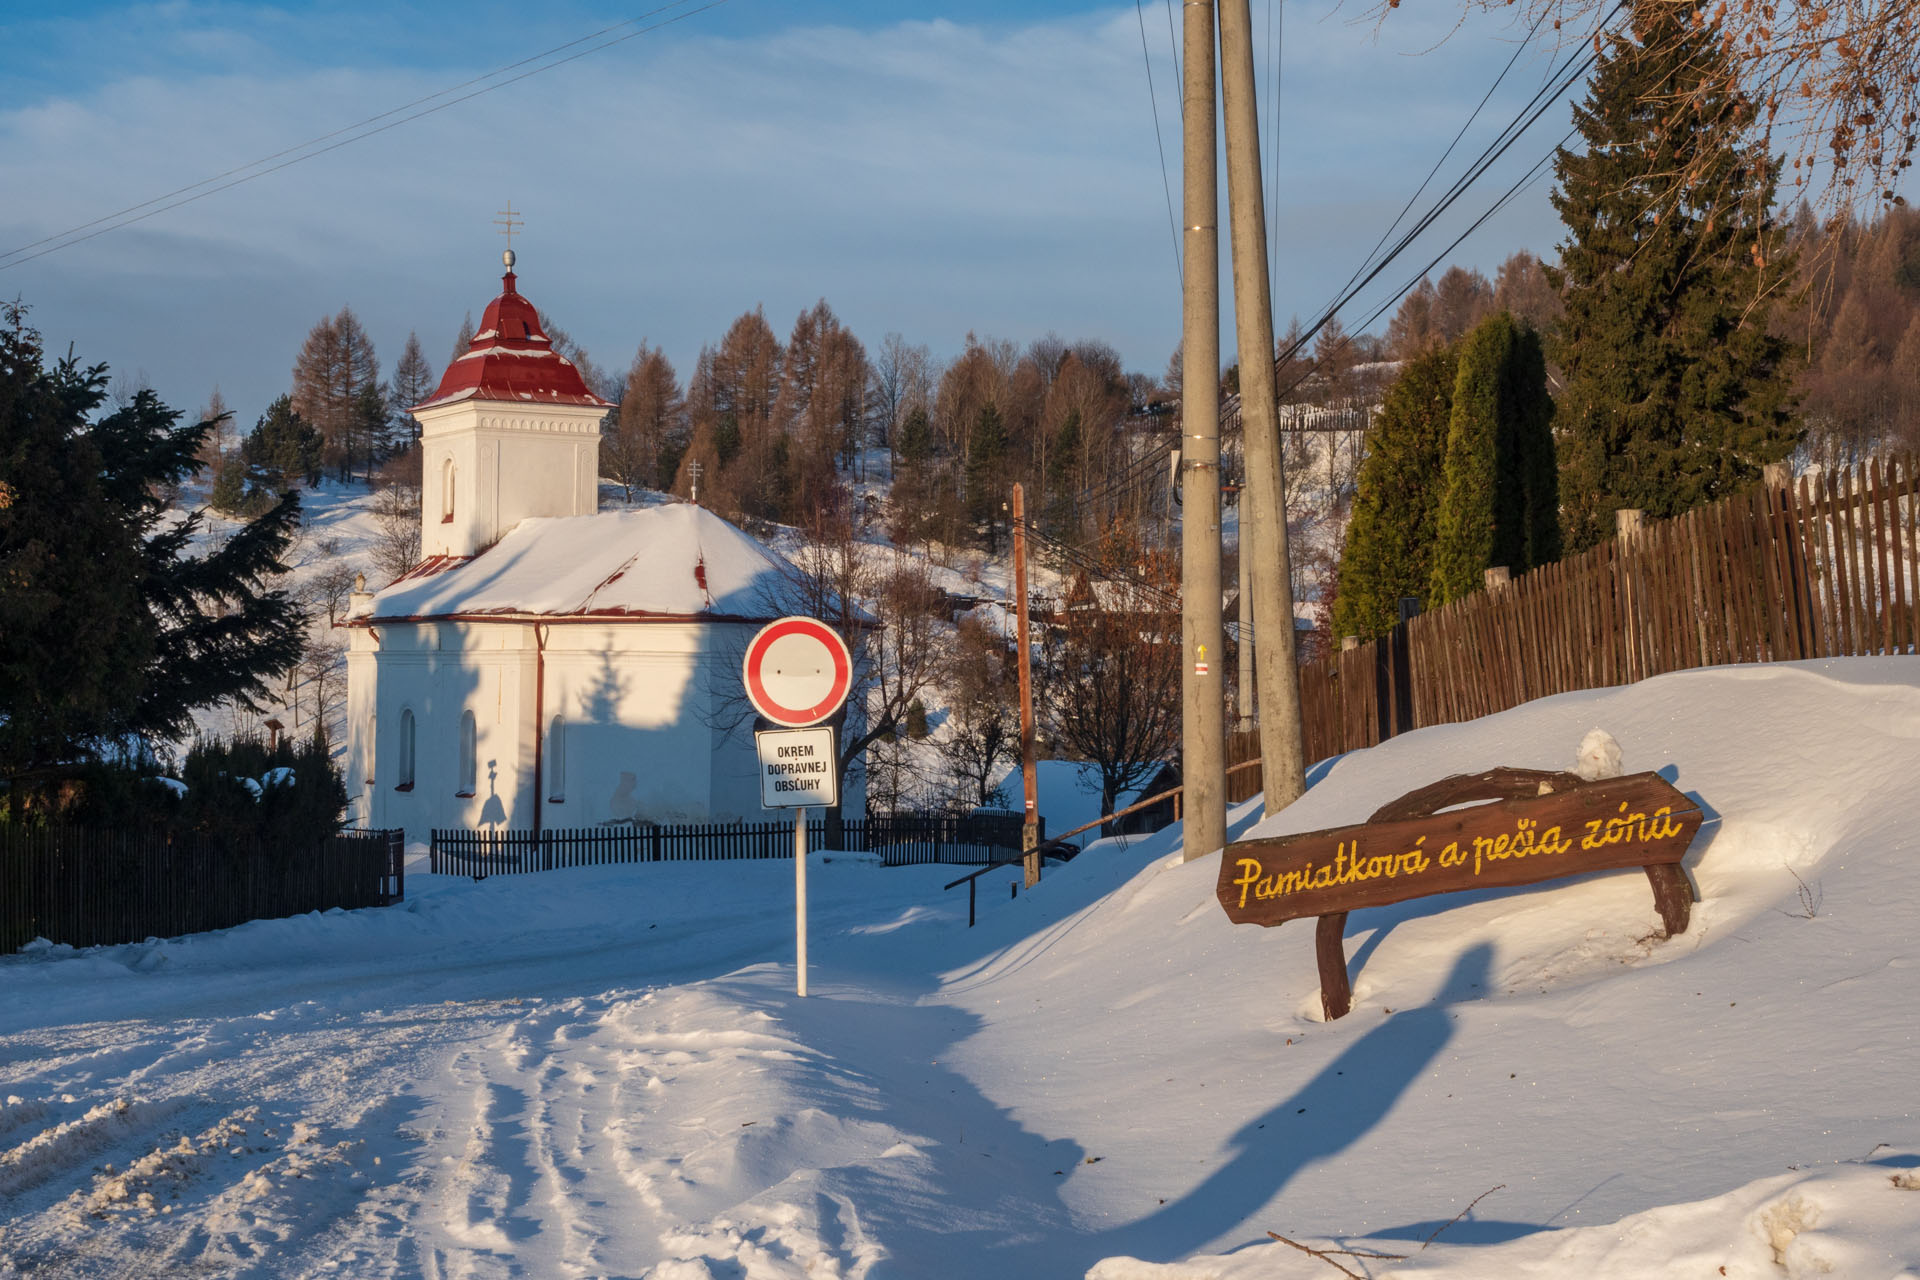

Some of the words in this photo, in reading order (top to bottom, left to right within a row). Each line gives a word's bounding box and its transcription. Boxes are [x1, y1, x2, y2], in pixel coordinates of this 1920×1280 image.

[777, 745, 814, 758] OKREM
[767, 761, 827, 775] DOPRAVNEJ
[775, 778, 821, 792] OBSLUHY
[1233, 836, 1430, 909] Pamiatková
[1438, 841, 1467, 868] a
[1472, 818, 1572, 875] pešia
[1581, 801, 1683, 849] zóna
